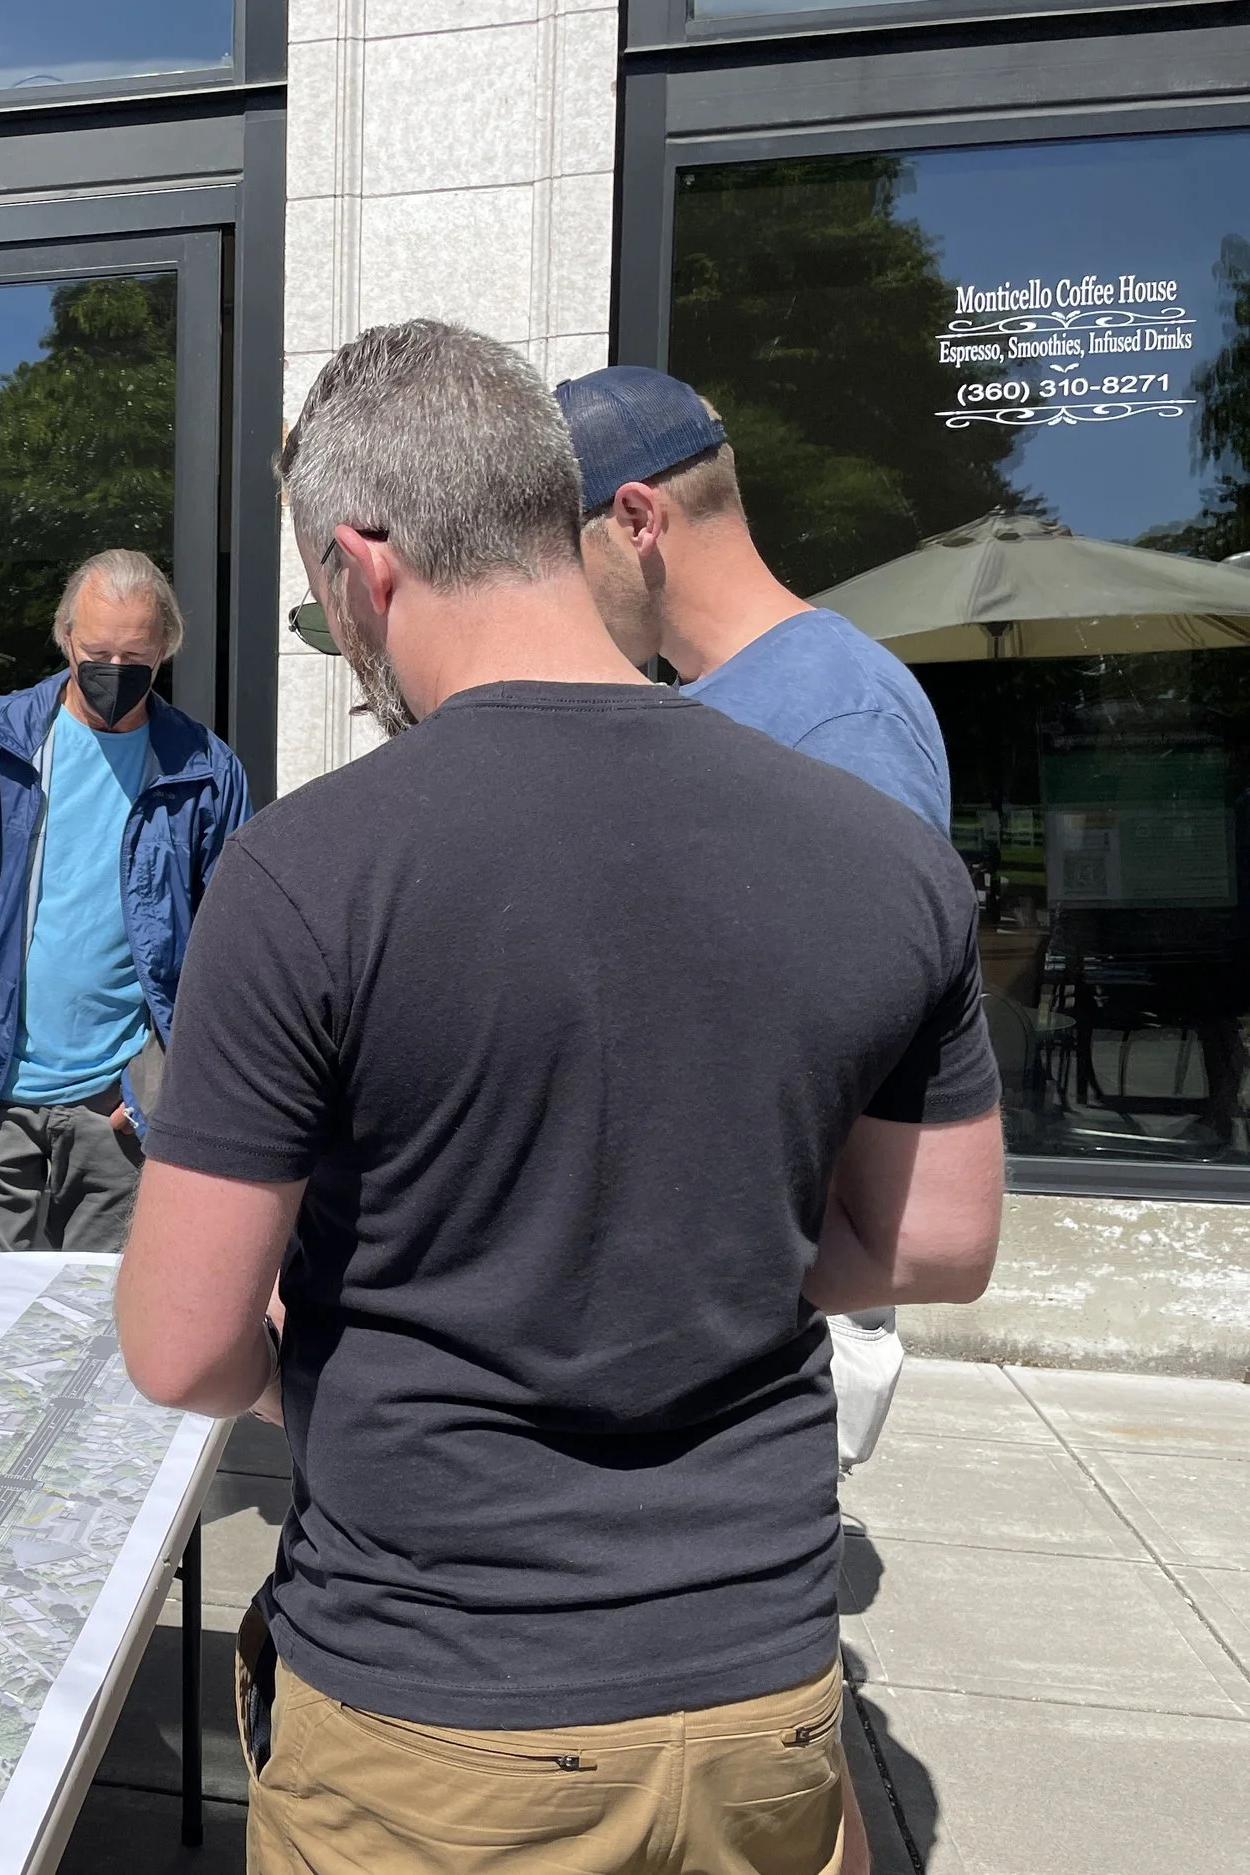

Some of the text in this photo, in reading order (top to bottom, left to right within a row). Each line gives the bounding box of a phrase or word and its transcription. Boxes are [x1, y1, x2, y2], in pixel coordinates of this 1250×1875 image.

[955, 275, 1178, 314] Monticello Coffee House
[939, 326, 1193, 367] Espresso, Smoothies, Infused Drinks
[957, 374, 1169, 407] (360) 310-8271
